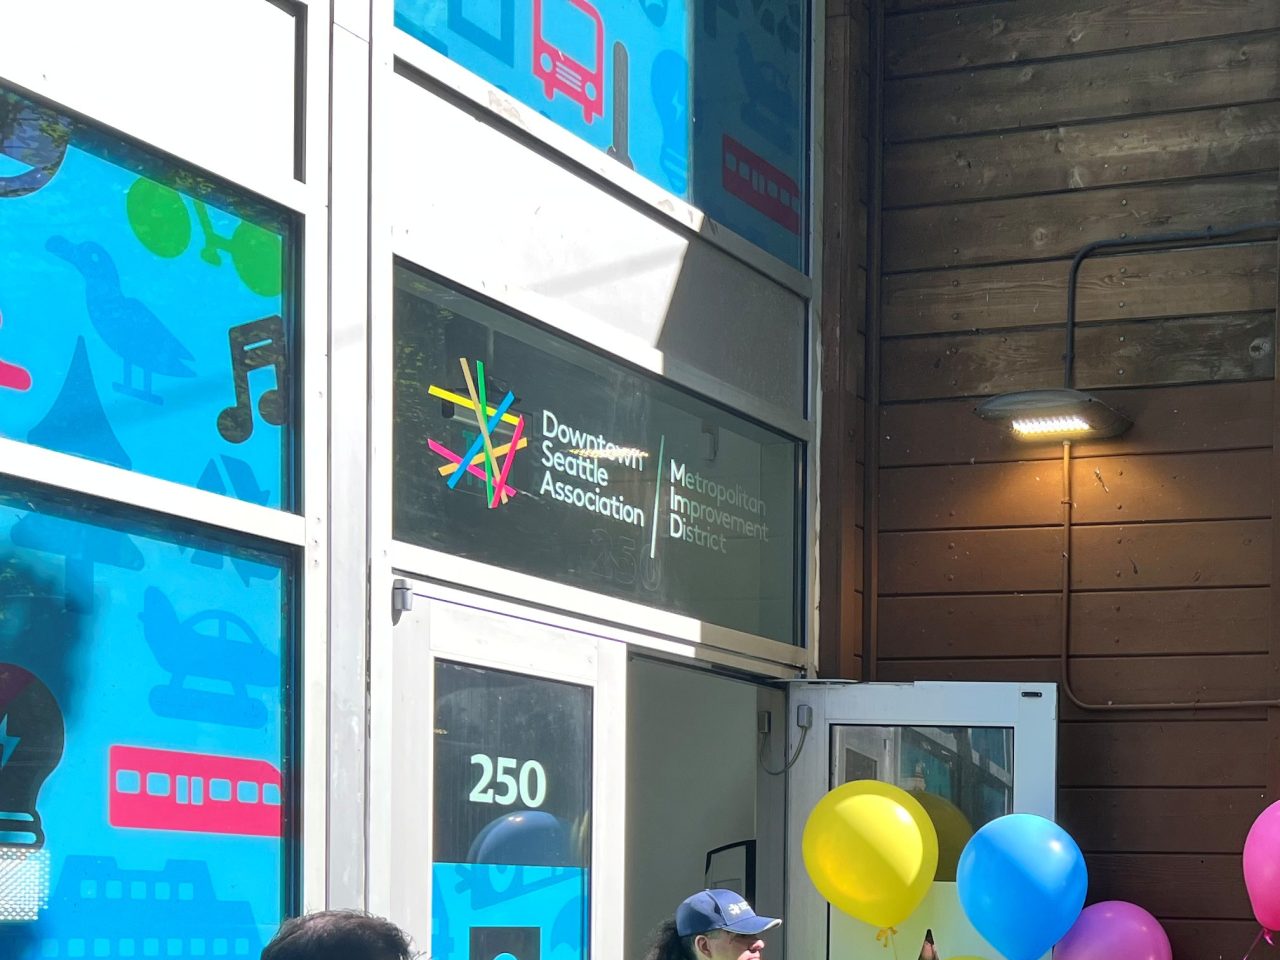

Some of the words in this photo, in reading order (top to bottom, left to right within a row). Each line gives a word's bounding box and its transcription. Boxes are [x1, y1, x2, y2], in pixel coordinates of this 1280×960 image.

[541, 440, 608, 486] Seattle
[543, 409, 643, 471] Downtown
[540, 470, 645, 527] Association
[670, 459, 766, 516] Metropolitan
[670, 486, 769, 542] Improvement
[670, 513, 727, 553] District
[469, 753, 547, 808] 250
